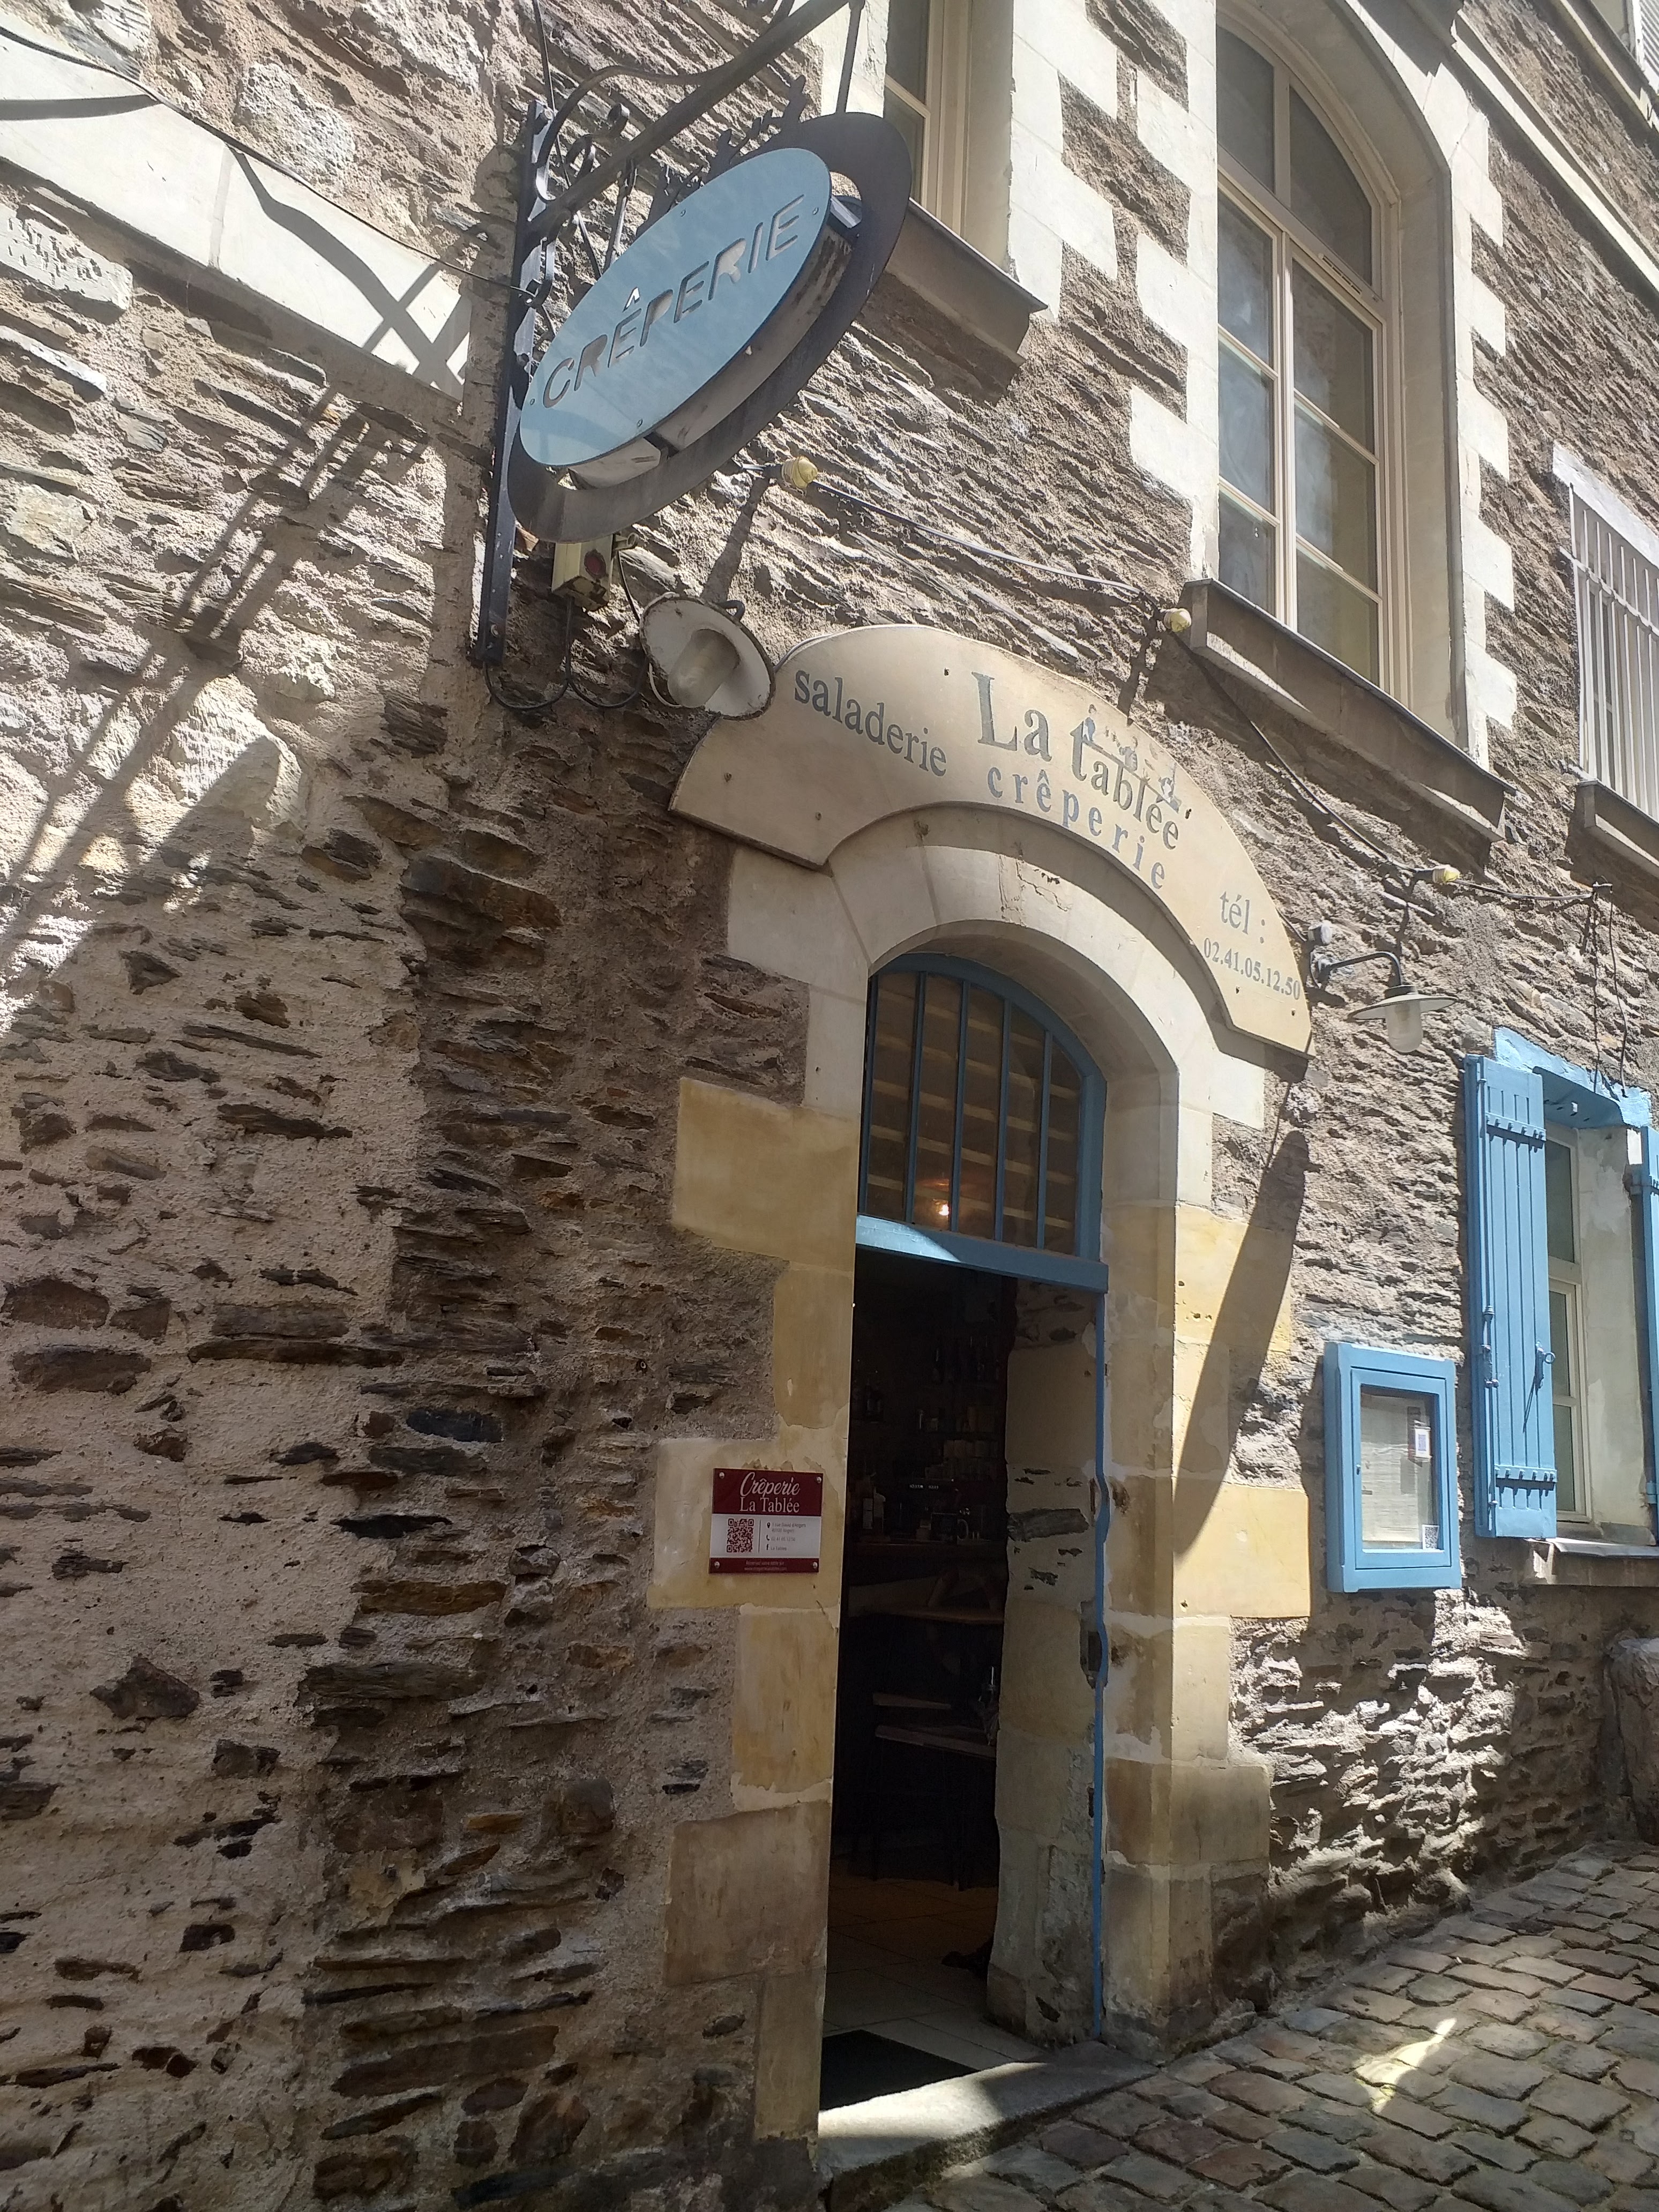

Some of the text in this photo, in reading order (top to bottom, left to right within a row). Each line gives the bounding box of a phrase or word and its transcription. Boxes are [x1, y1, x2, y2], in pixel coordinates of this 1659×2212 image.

[542, 194, 805, 408] CRÊPERIE
[795, 670, 946, 777] saladerie
[971, 671, 1052, 762] La
[987, 766, 1165, 890] crêperie
[1220, 891, 1250, 936] tél
[1204, 937, 1301, 1000] 02.41.05.12.50
[739, 1471, 801, 1498] Crêperie
[739, 1497, 800, 1513] La Tablée
